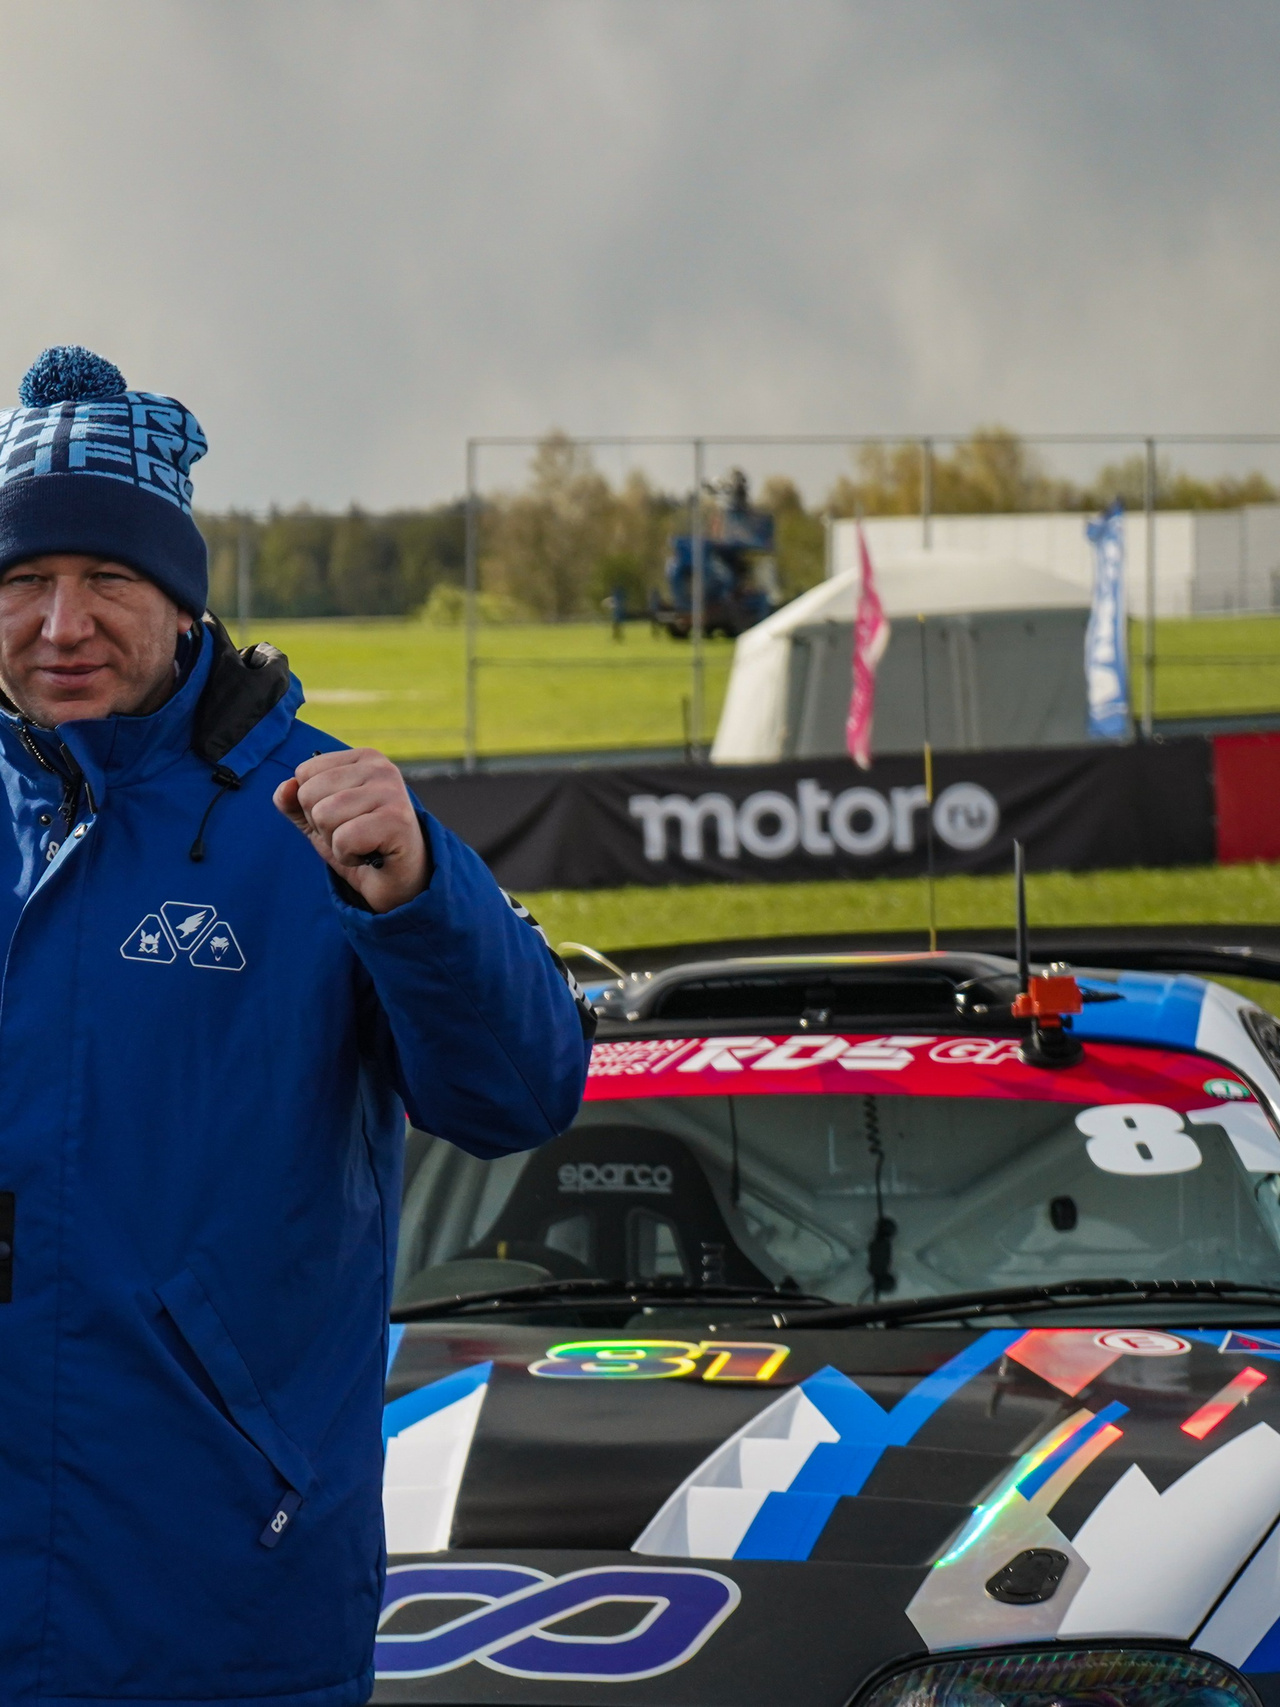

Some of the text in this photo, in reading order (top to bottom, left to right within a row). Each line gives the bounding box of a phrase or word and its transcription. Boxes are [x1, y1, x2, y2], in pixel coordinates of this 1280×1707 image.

[628, 779, 932, 861] motor
[675, 1035, 938, 1072] RDS
[528, 1339, 791, 1381] 81
